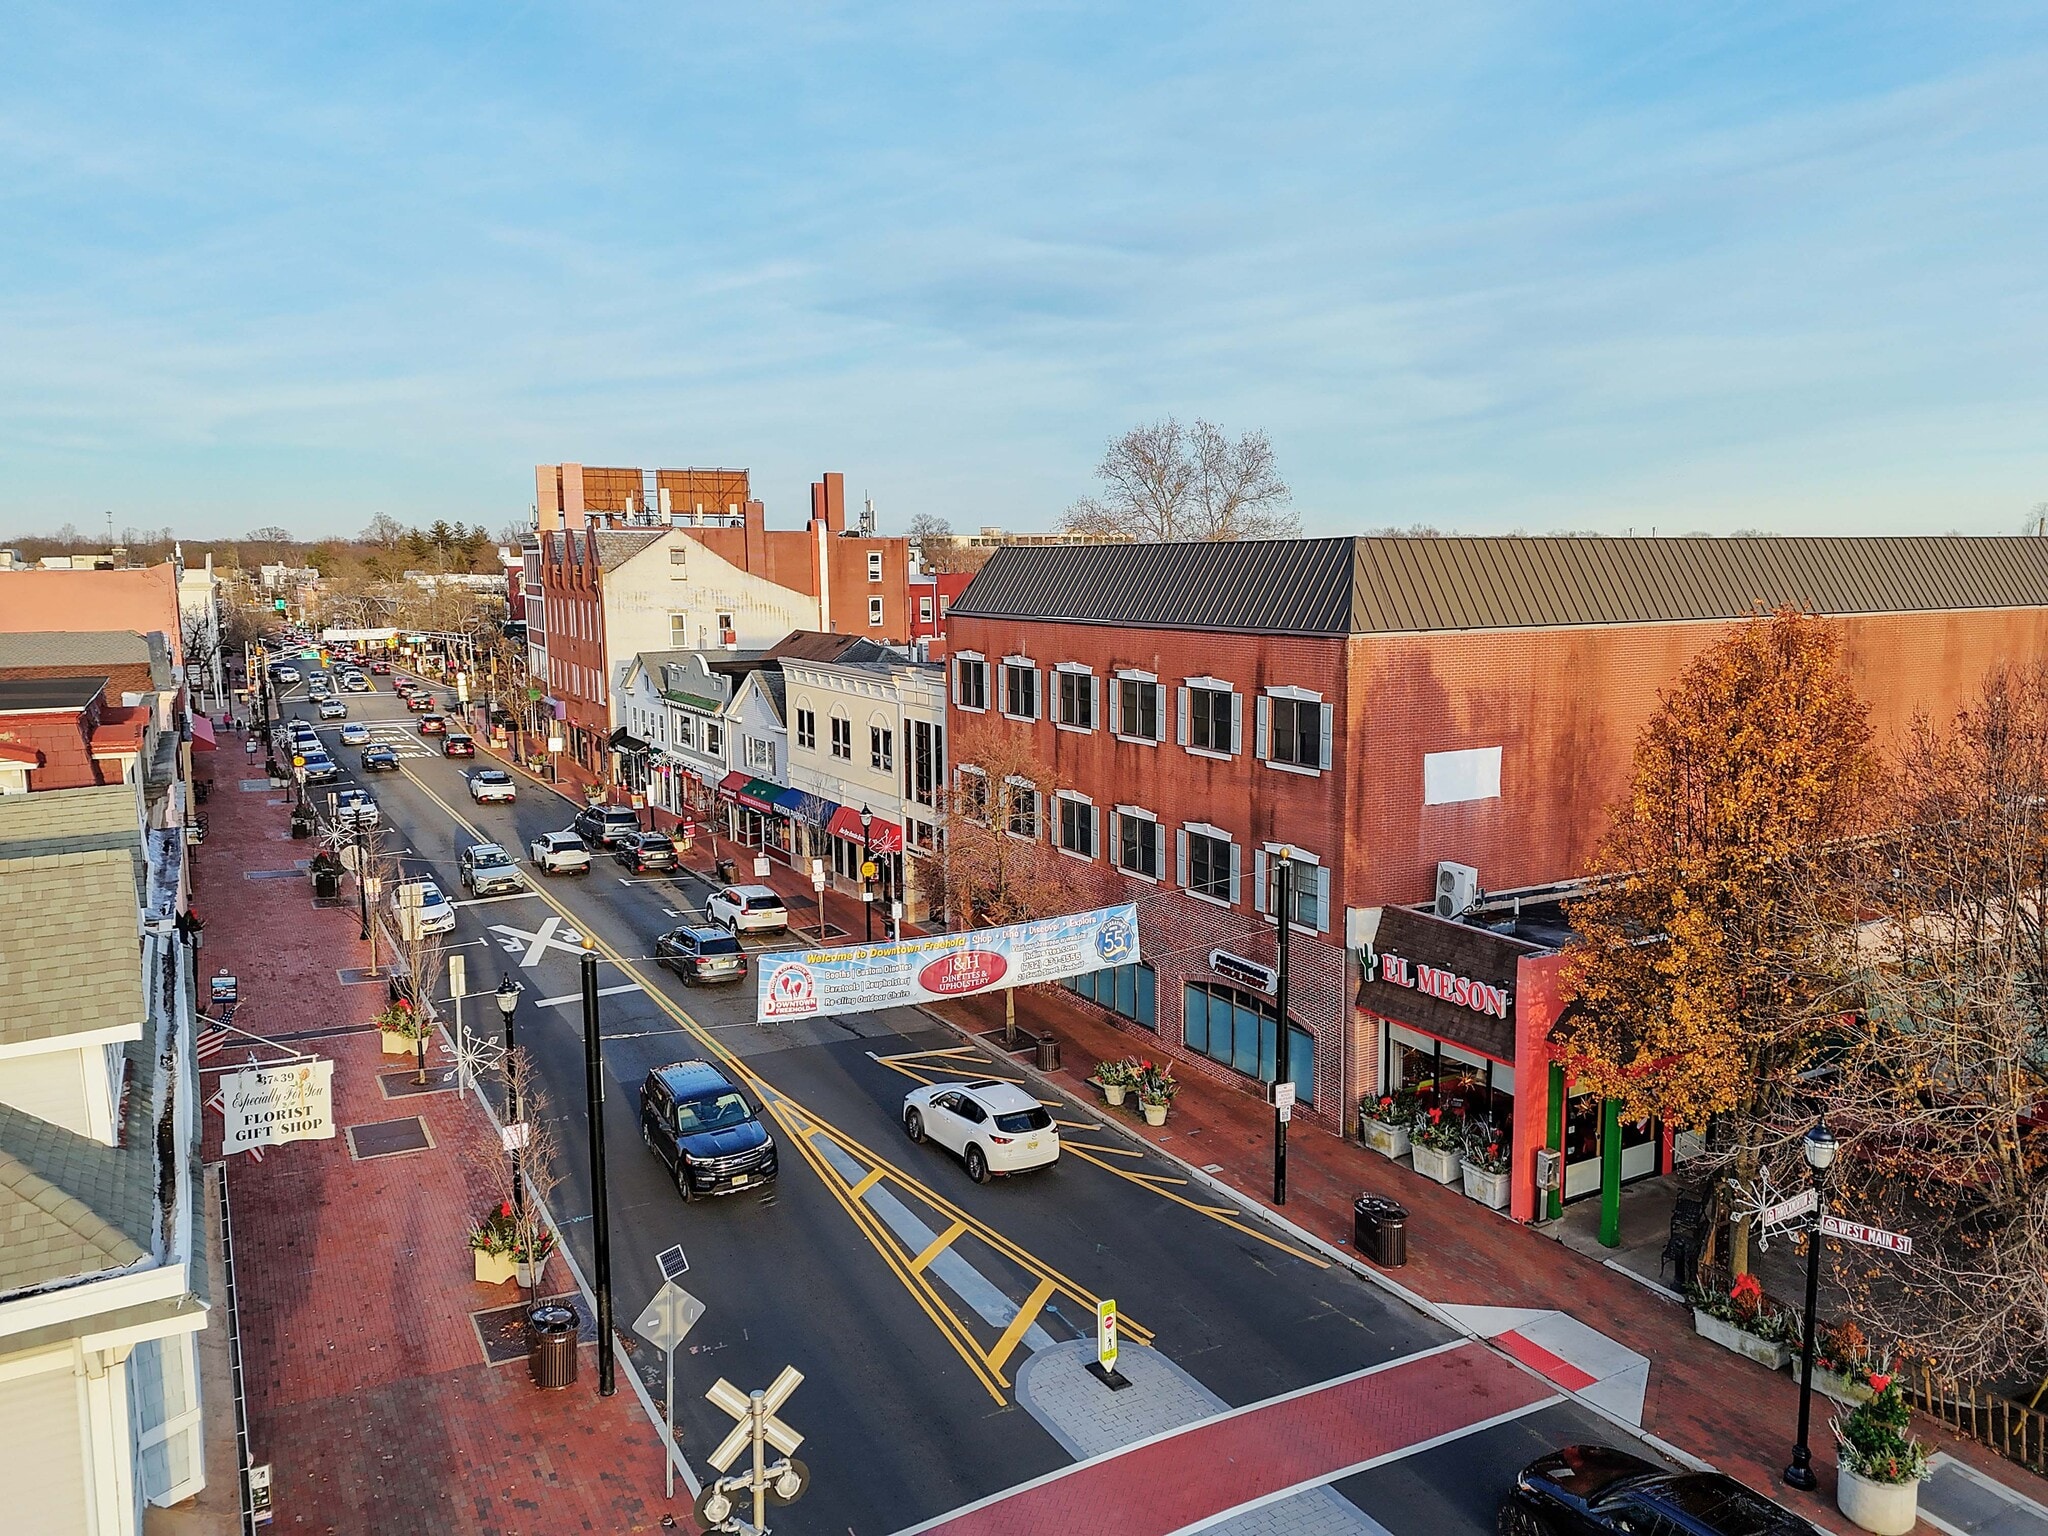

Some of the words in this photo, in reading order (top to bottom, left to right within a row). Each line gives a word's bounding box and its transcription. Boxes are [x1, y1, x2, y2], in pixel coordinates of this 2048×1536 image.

[971, 935, 993, 945] Shop
[1028, 923, 1060, 935] Discover
[1069, 916, 1097, 928] Explore
[1104, 930, 1124, 952] 55
[807, 951, 852, 964] Welcome
[856, 951, 867, 960] to
[869, 944, 921, 958] Downtown
[924, 938, 966, 951] Freehold
[825, 970, 851, 980] Booths
[856, 966, 882, 976] Custom
[883, 963, 912, 974] Dinettes
[947, 953, 980, 975] J&H
[824, 982, 860, 993] Barstools
[865, 976, 911, 989] Reupholstery
[939, 977, 990, 991] UPHOLSTERY
[942, 970, 981, 983] DINETTES
[1381, 953, 1415, 988] EL
[1416, 964, 1508, 1020] MESON
[766, 997, 816, 1014] DOWNTOWN
[857, 993, 887, 1003] Outdoor
[887, 990, 910, 1001] Chairs
[281, 1073, 294, 1083] 39
[232, 1087, 282, 1113] Especially
[284, 1083, 303, 1100] For
[304, 1082, 324, 1097] You
[244, 1105, 314, 1126] FLORIST
[235, 1126, 273, 1142] GIFT
[281, 1118, 323, 1135] SHOP
[1838, 1221, 1866, 1240] WEST
[1868, 1229, 1893, 1248] MAIN
[1896, 1237, 1910, 1252] ST
